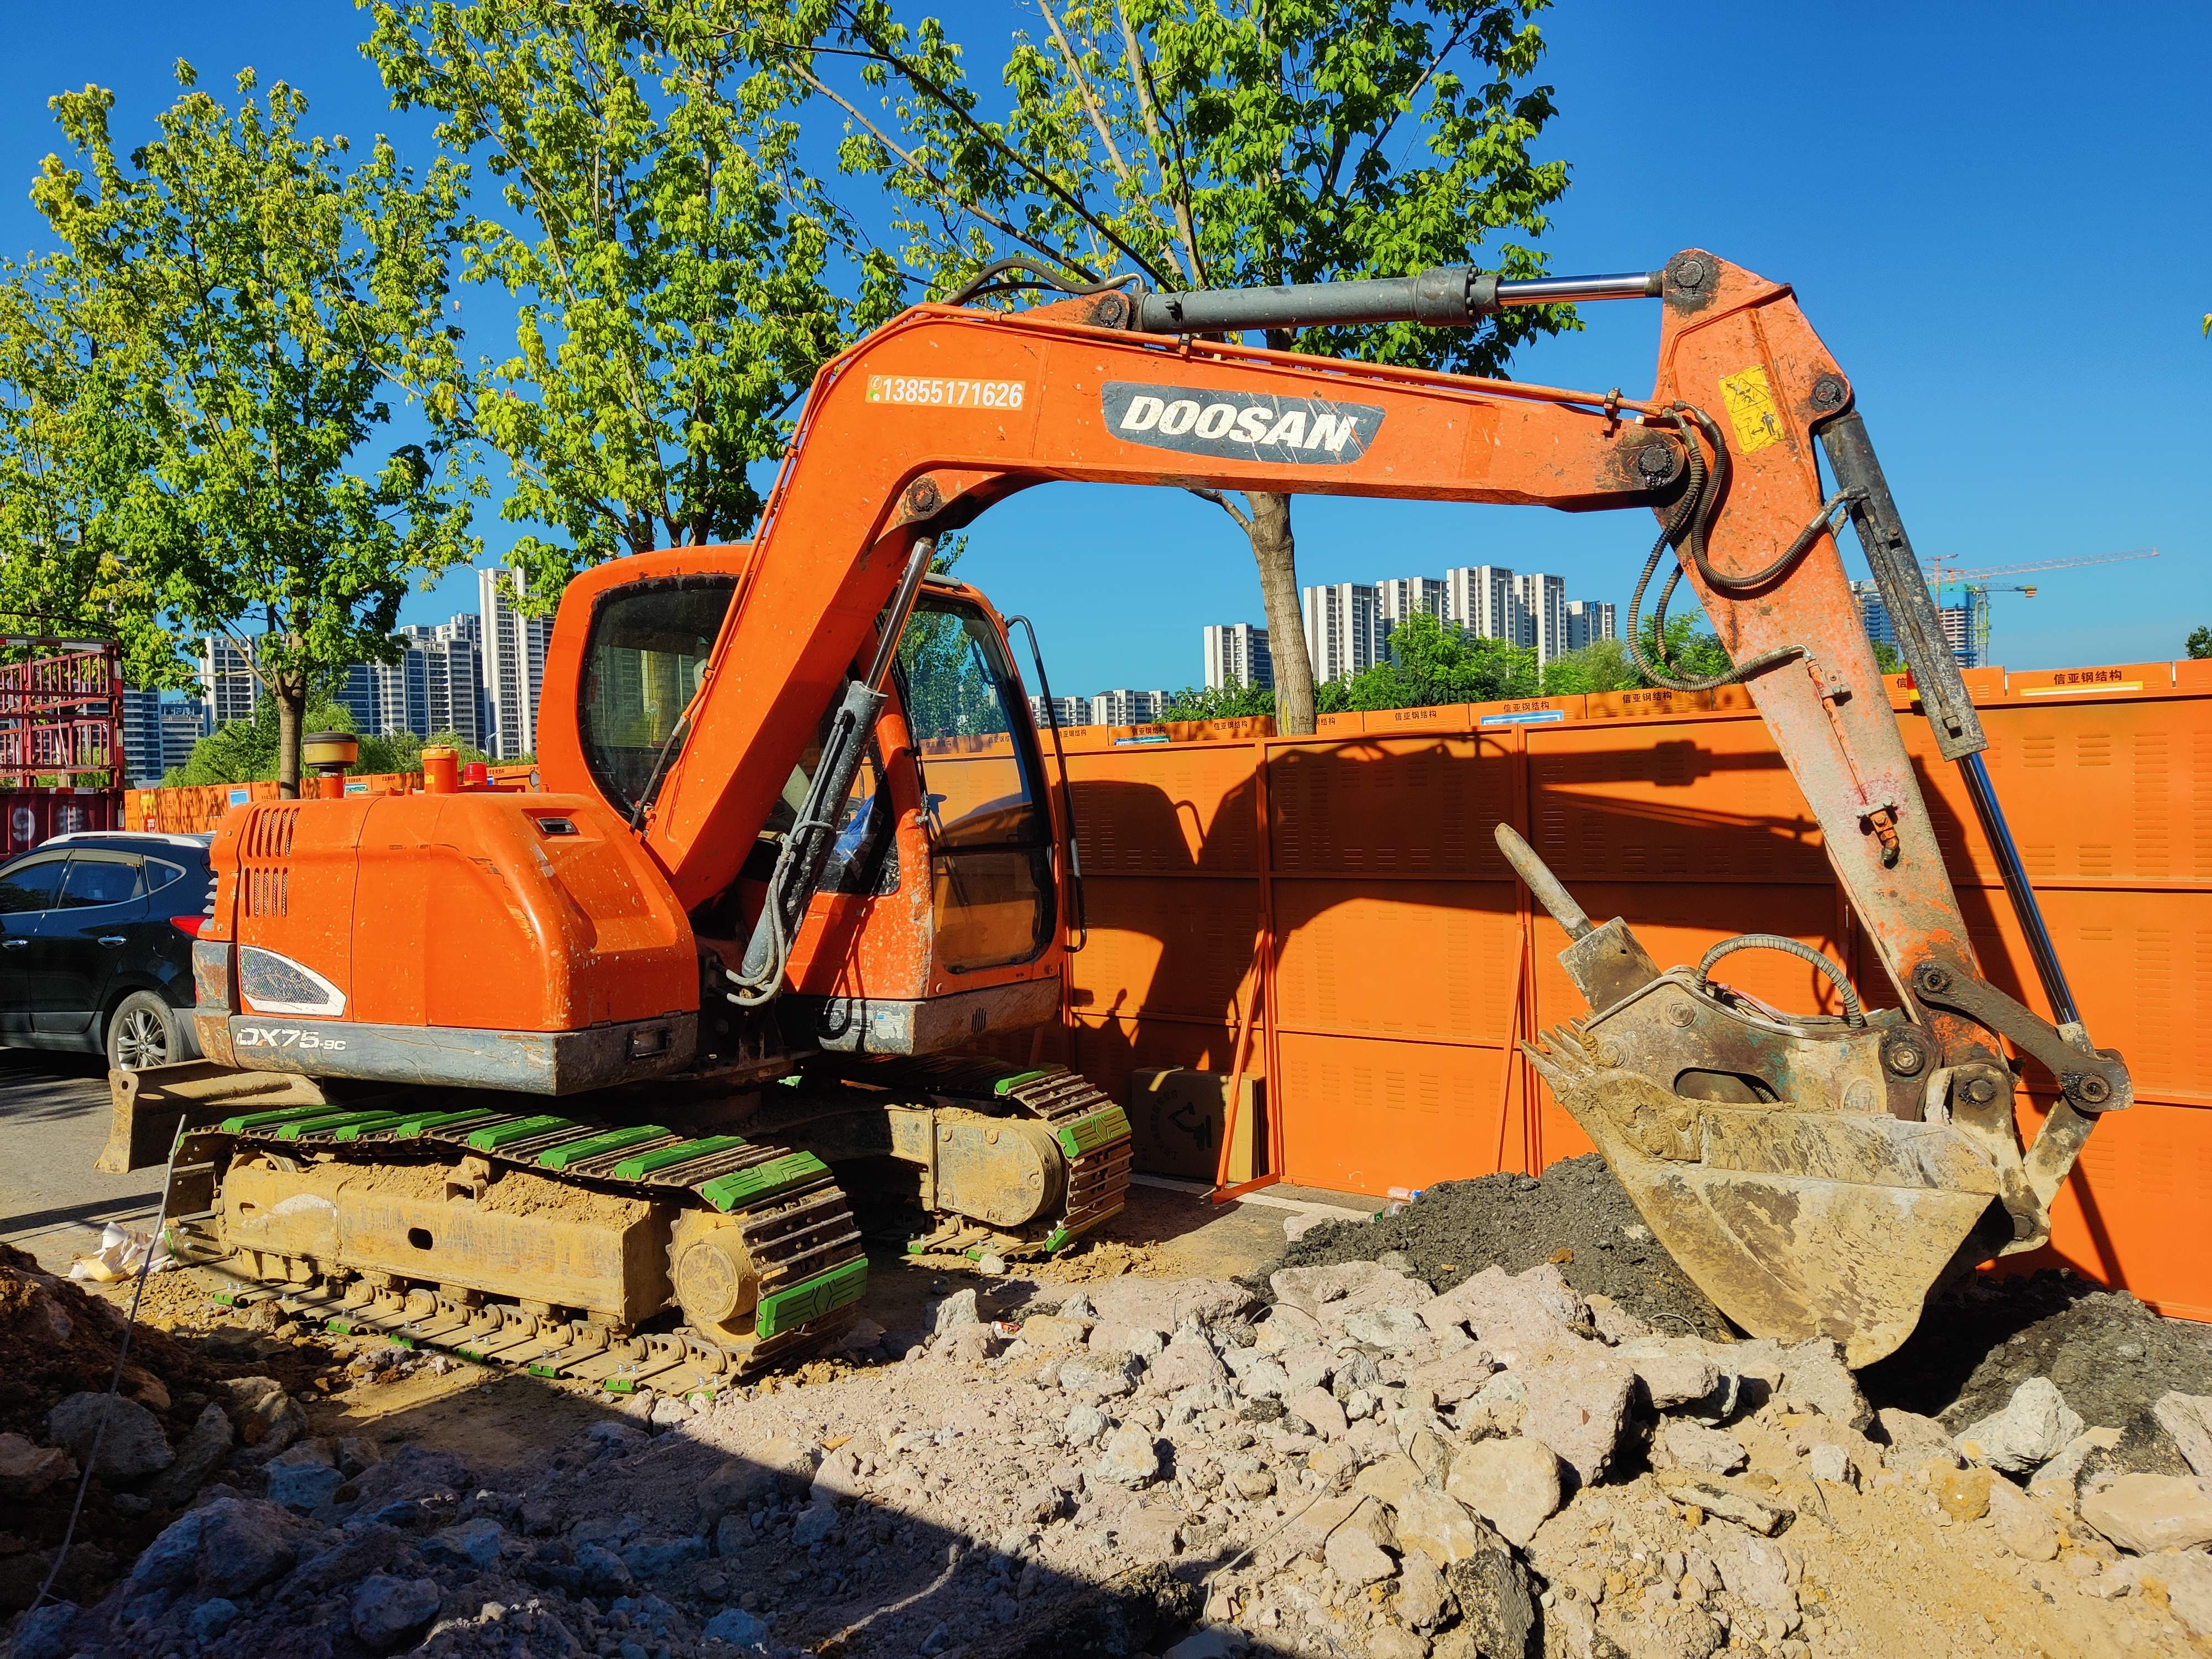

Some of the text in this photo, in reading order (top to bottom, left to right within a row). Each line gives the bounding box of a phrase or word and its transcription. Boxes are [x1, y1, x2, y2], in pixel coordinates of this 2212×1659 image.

[883, 378, 1023, 408] 13855171626
[1119, 395, 1359, 452] DOOSAN
[2054, 670, 2122, 685] 信亚钢结构
[1622, 691, 1672, 704] 信亚钢结构
[1504, 701, 1550, 713] 信亚钢结构
[1395, 709, 1437, 722] 信亚钢结构
[1132, 726, 1166, 736] 信亚钢结构
[1214, 720, 1248, 731] 信亚钢结构
